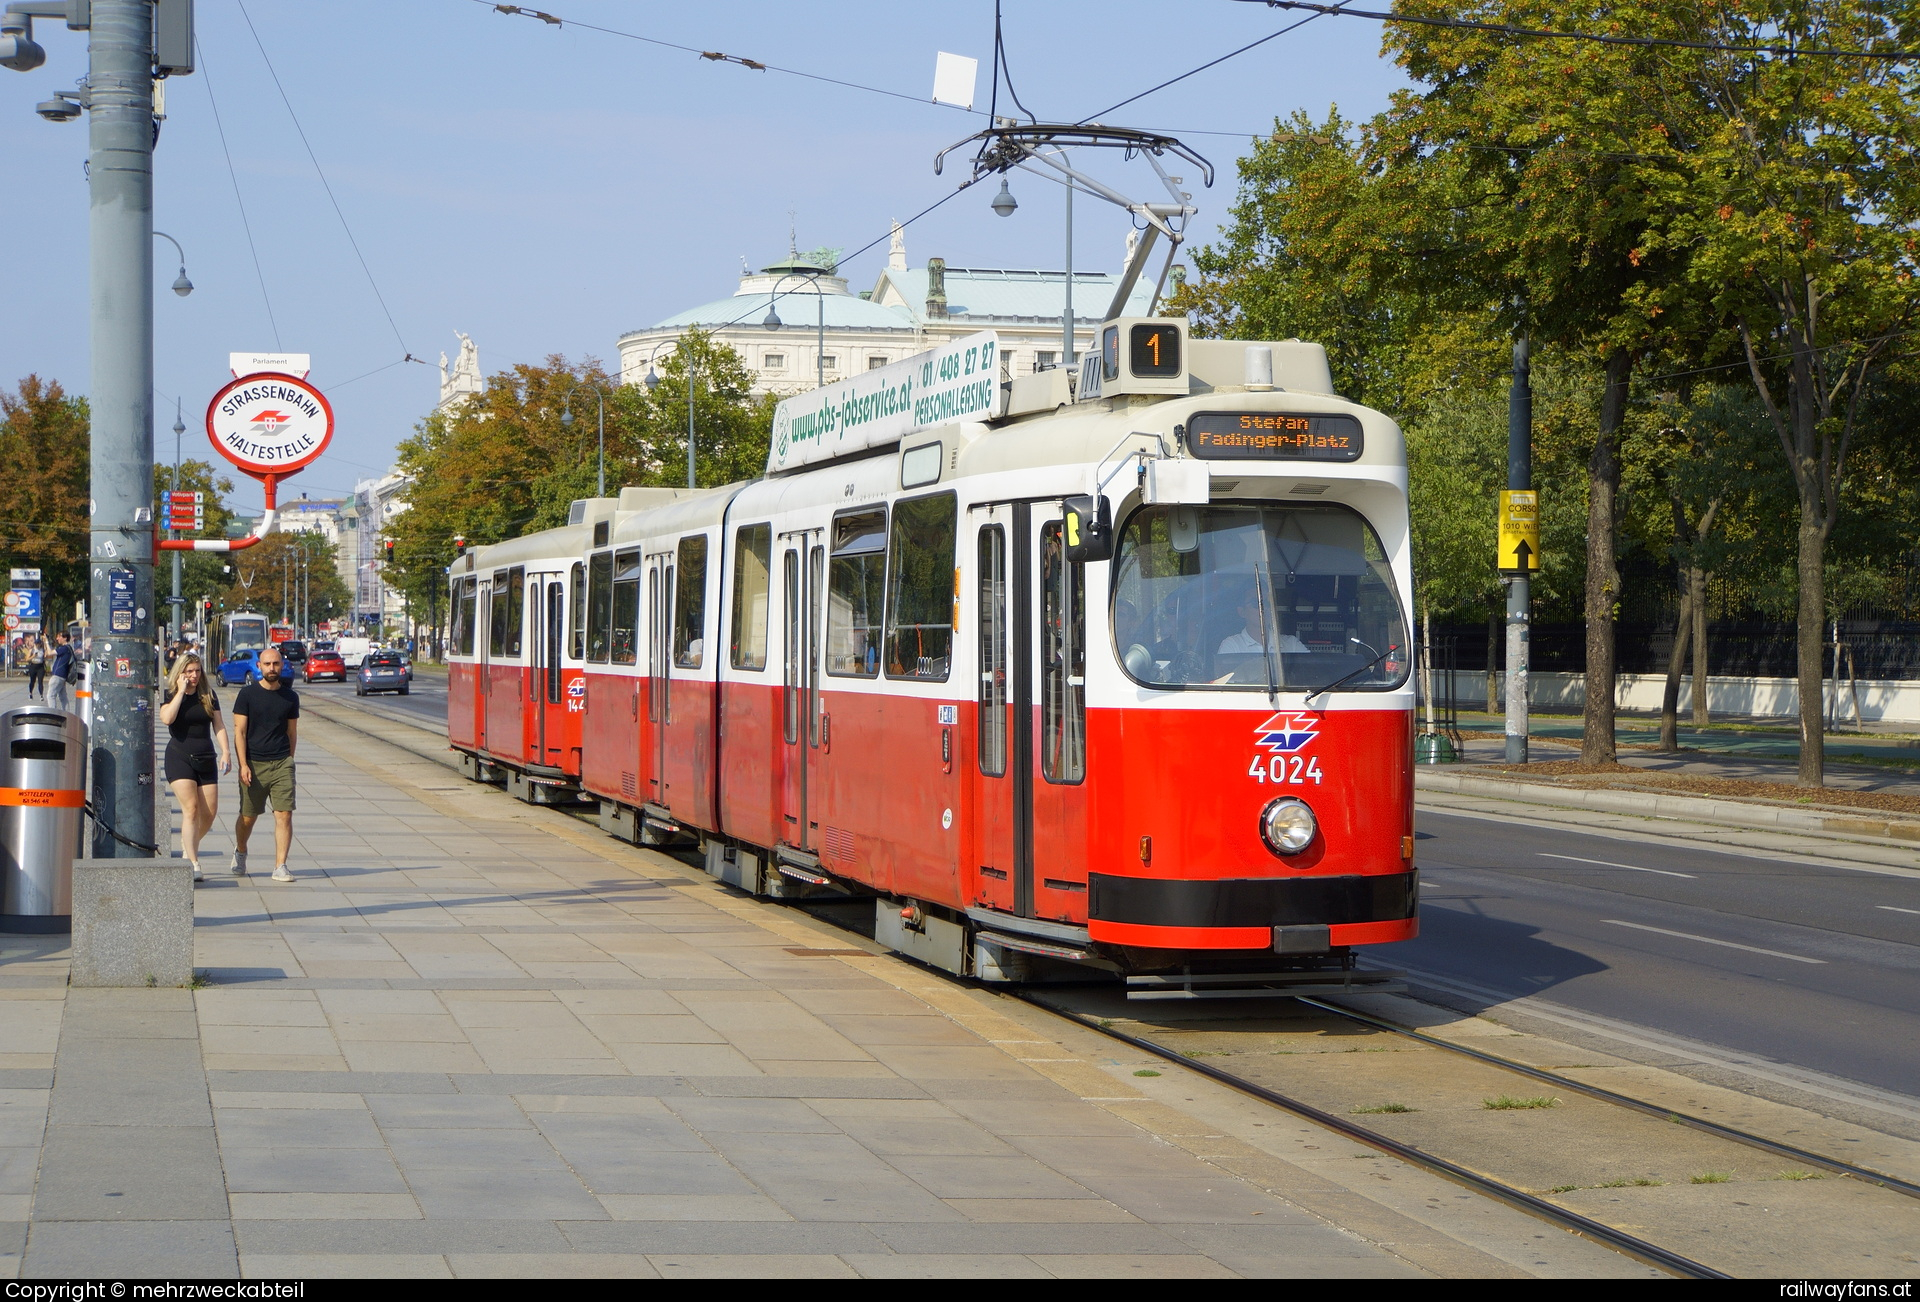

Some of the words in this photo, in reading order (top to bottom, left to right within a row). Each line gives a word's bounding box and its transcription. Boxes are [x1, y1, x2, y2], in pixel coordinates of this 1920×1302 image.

[964, 346, 977, 376] 27
[981, 341, 994, 370] 27
[1146, 333, 1159, 366] 1
[222, 385, 320, 419] STRASSENBAHN
[791, 375, 912, 446] www.pbs-jobservice.at
[914, 378, 992, 426] PERSONALLEASING
[1240, 415, 1308, 430] Stefan
[225, 431, 315, 460] HALTESTELLE
[1199, 432, 1349, 448] Fadinger-Platz
[1508, 504, 1537, 513] CORSO
[1503, 522, 1520, 530] 1010
[1247, 754, 1323, 784] 4024
